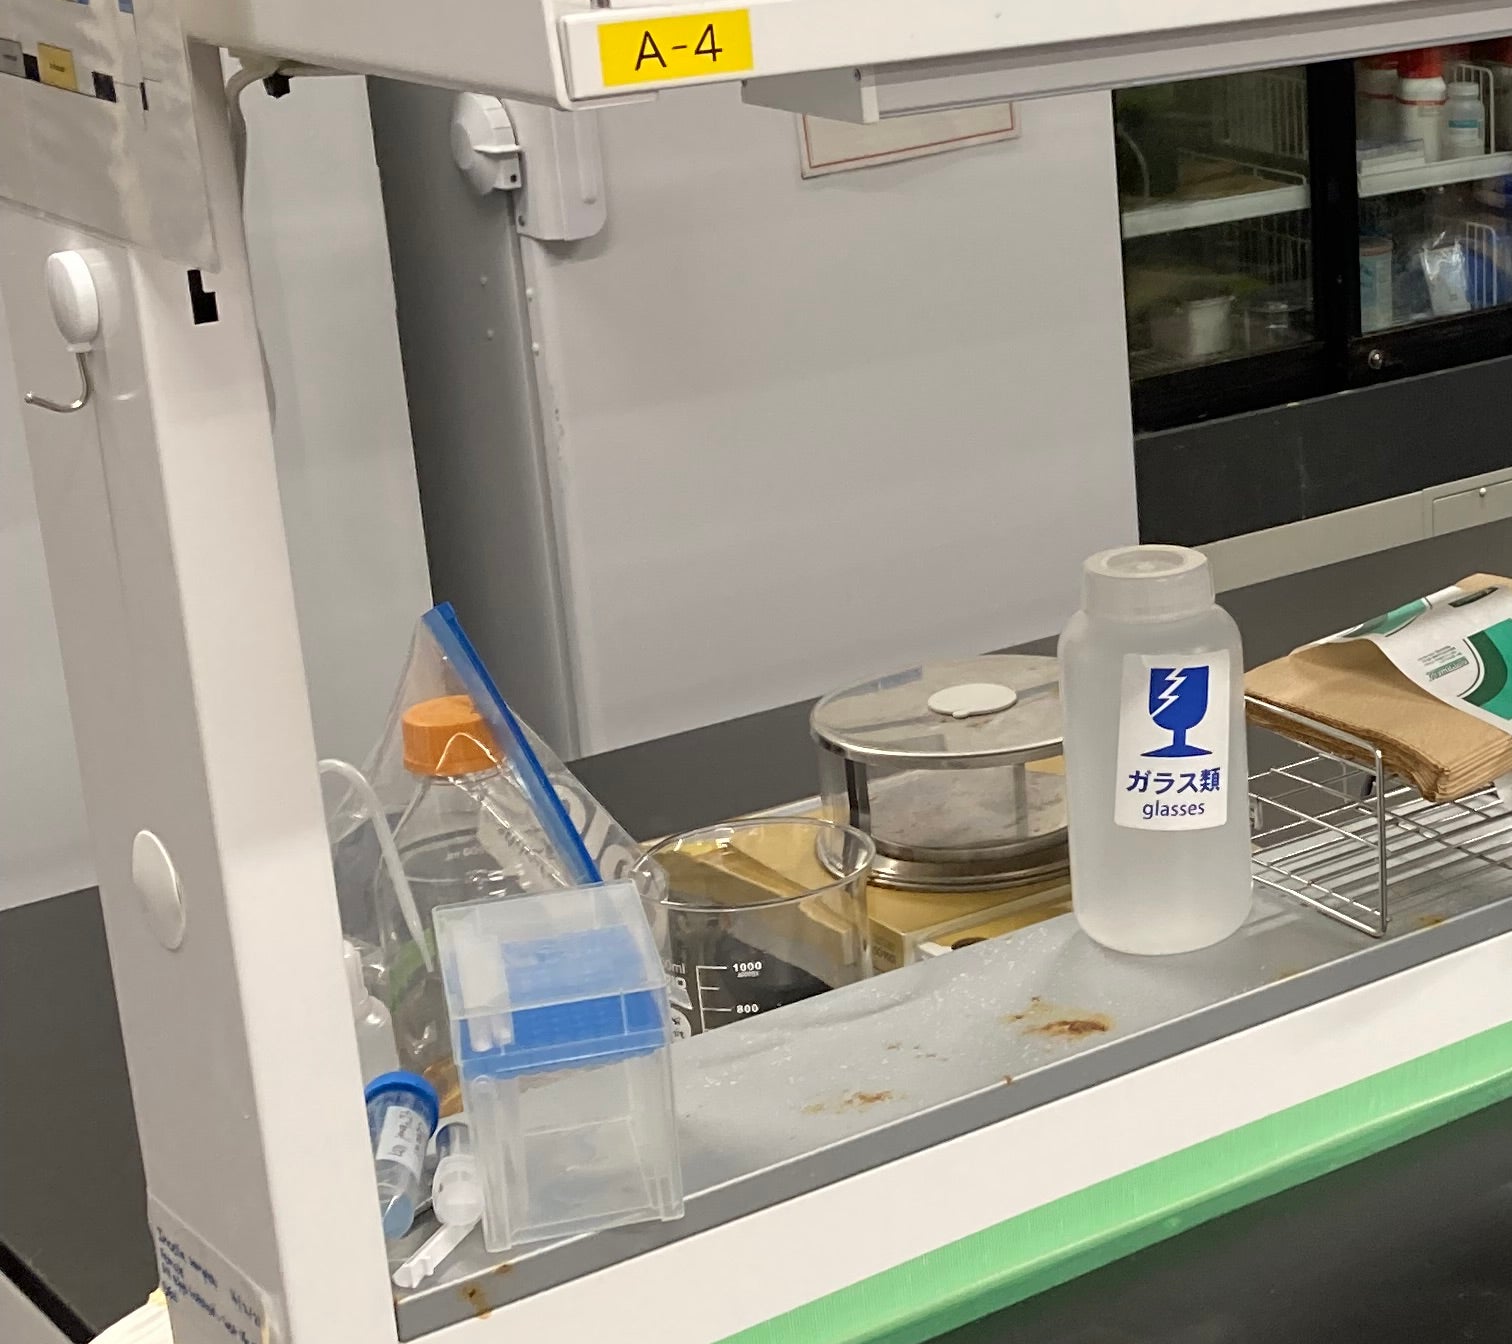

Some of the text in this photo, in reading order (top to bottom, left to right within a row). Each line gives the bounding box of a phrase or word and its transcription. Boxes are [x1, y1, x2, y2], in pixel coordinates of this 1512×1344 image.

[634, 23, 723, 71] A-4
[1126, 767, 1221, 795] ガラス類
[1142, 799, 1205, 820] glasses
[732, 961, 762, 973] 1000
[736, 1003, 760, 1014] 800
